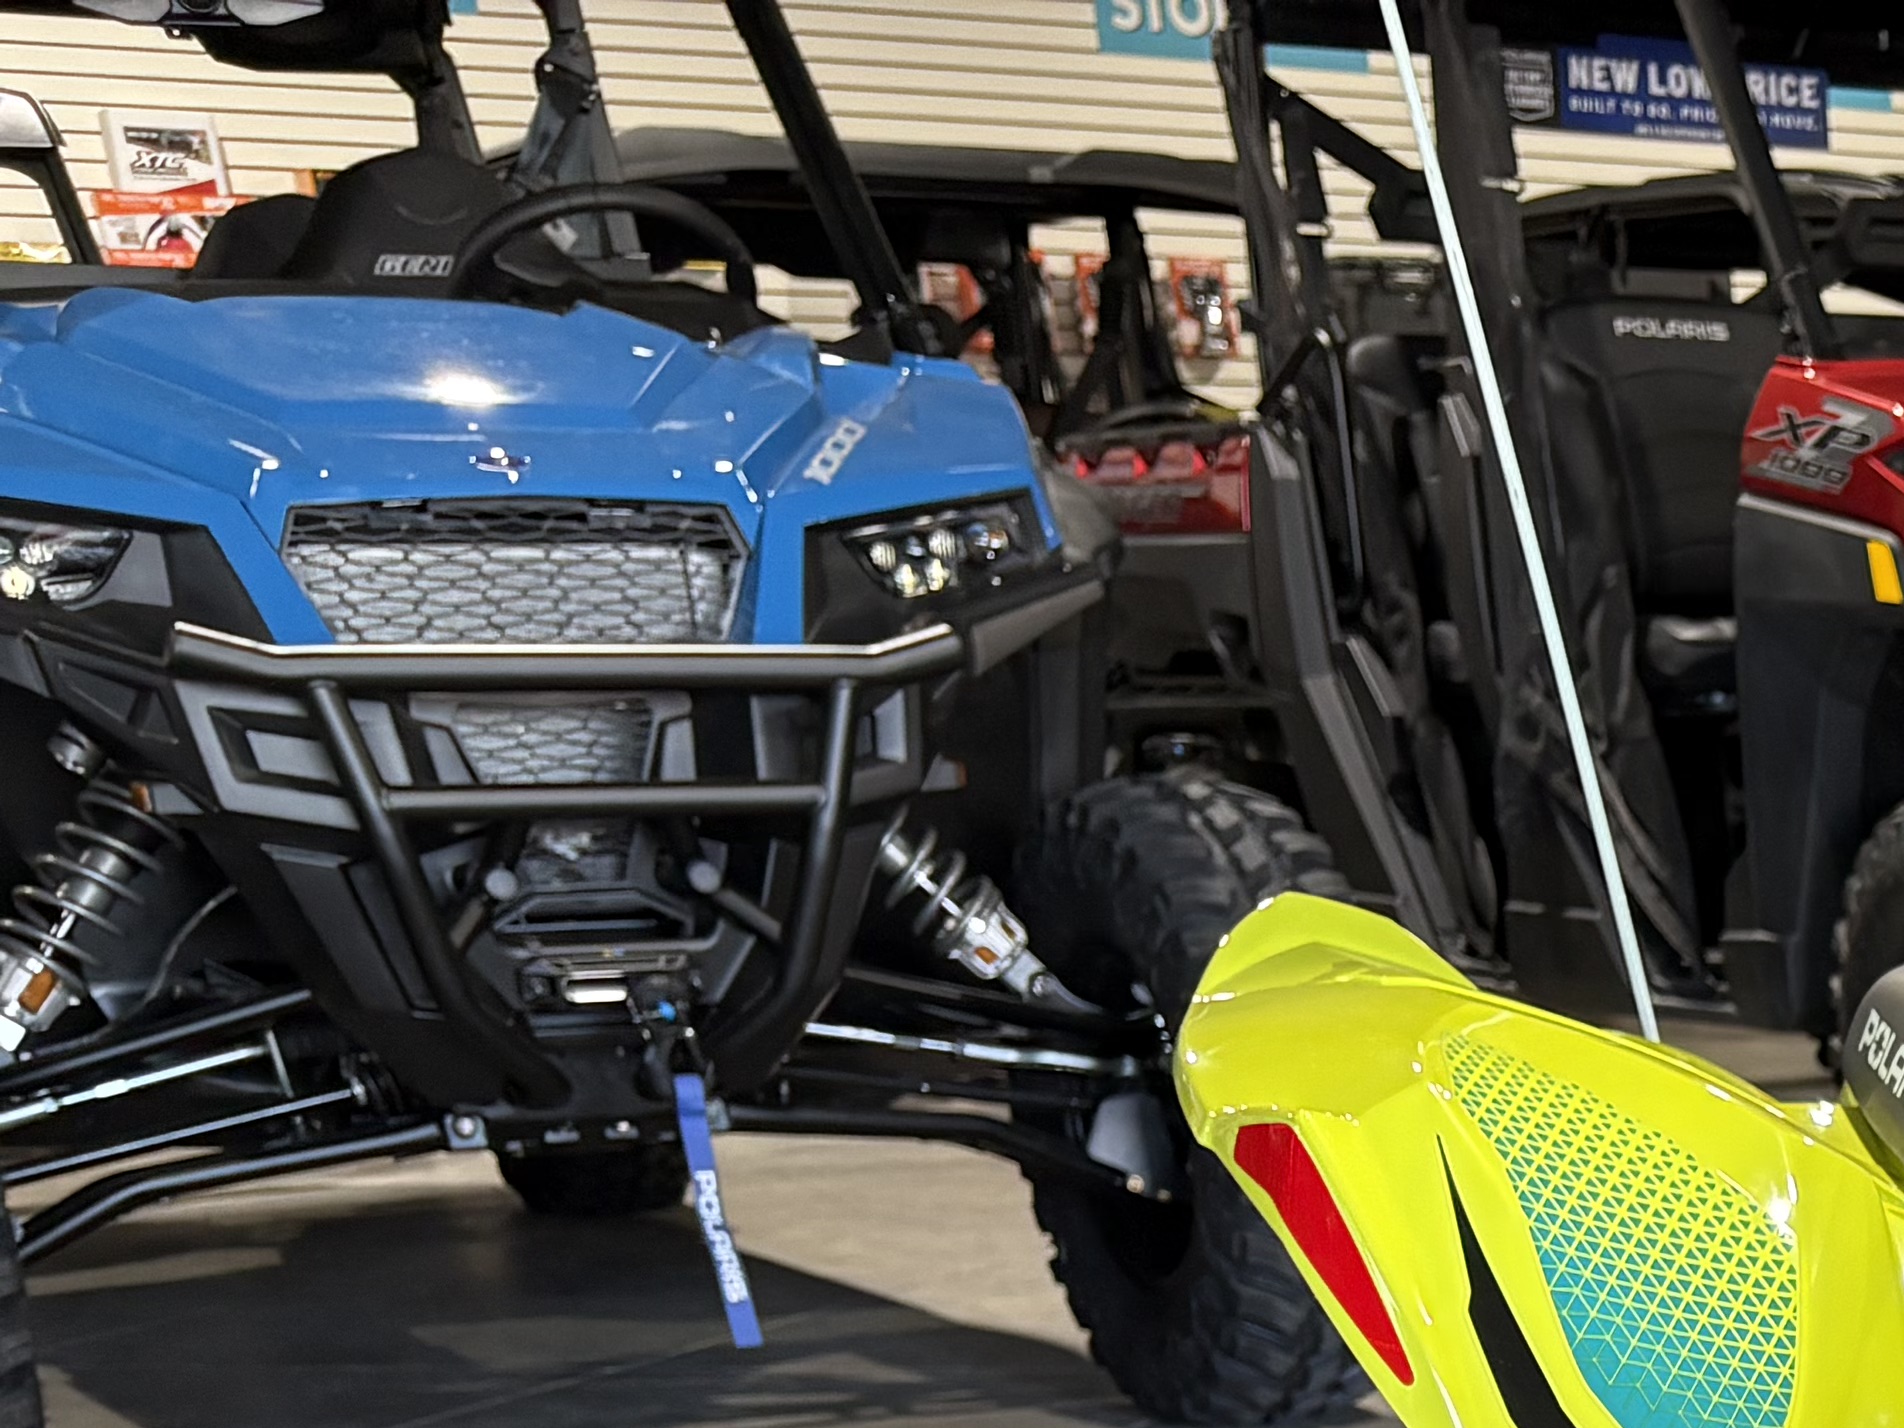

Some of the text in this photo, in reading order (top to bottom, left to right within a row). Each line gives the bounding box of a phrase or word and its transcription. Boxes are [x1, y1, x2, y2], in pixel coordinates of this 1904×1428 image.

[1110, 0, 1228, 37] STO
[1567, 56, 1640, 95] NEW
[1745, 71, 1820, 109] RICE
[1612, 316, 1730, 342] POLARIS
[803, 418, 867, 485] 1000
[1752, 405, 1873, 452] XP
[691, 1168, 749, 1306] POLARIS
